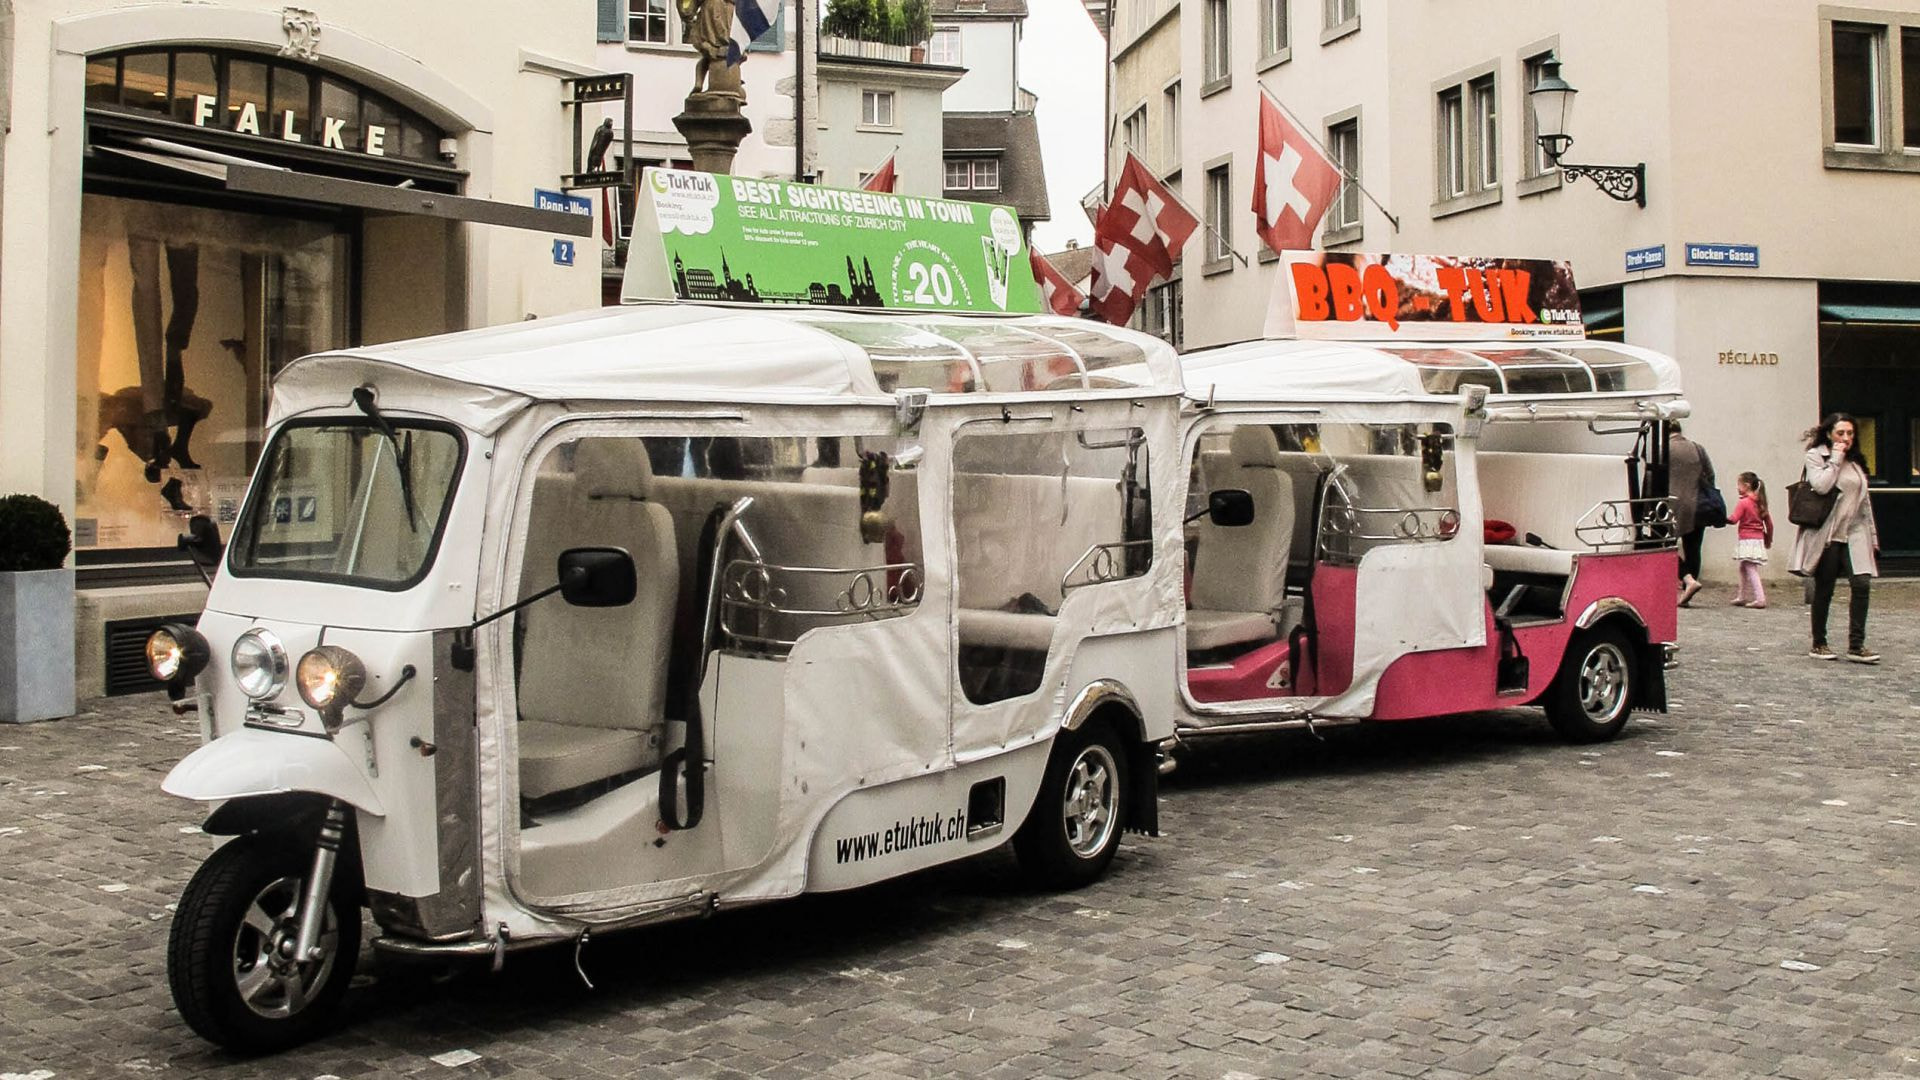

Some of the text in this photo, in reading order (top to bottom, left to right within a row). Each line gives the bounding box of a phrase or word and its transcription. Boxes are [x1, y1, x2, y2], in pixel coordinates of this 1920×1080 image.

[577, 82, 622, 93] FALKE
[194, 94, 384, 156] FALKE
[731, 179, 974, 224] BEST SIGHTSEEING IN TOWN
[738, 205, 758, 219] SEE
[760, 208, 778, 221] ALL
[779, 210, 840, 227] ATTRACTIONS
[842, 215, 855, 226] OF
[889, 220, 907, 232] CITY
[561, 244, 568, 260] 2
[1691, 248, 1755, 262] Glocken-Gasse
[1290, 262, 1400, 332] BBQ
[1436, 268, 1538, 324] TUK
[1719, 350, 1779, 366] PÉCLARD
[837, 808, 965, 864] www.etuktuk.ch
